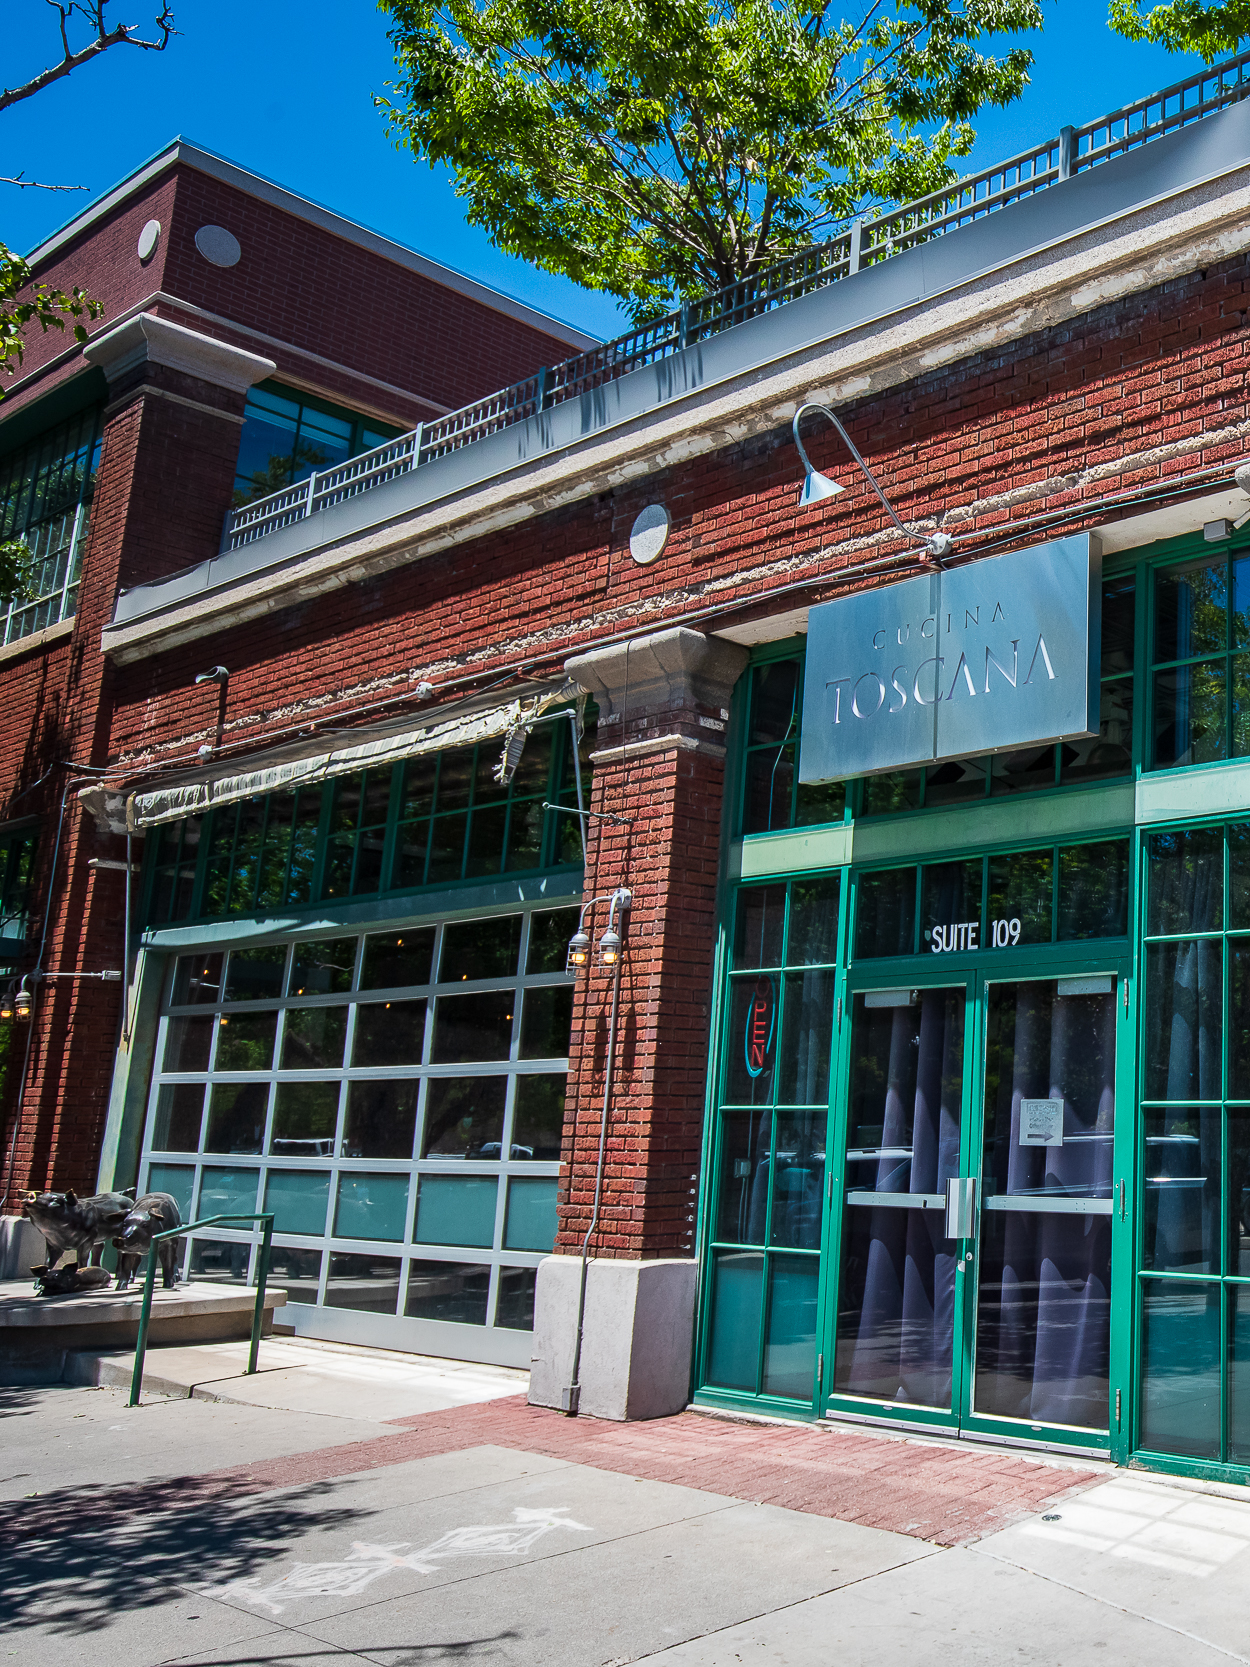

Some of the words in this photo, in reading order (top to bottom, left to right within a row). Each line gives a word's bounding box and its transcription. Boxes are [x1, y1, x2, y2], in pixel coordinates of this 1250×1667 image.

[873, 602, 1005, 649] CUCINA
[826, 633, 1059, 724] TOSCANA
[931, 922, 979, 953] SUITE
[992, 918, 1021, 948] 109
[751, 976, 770, 1067] OPEN
